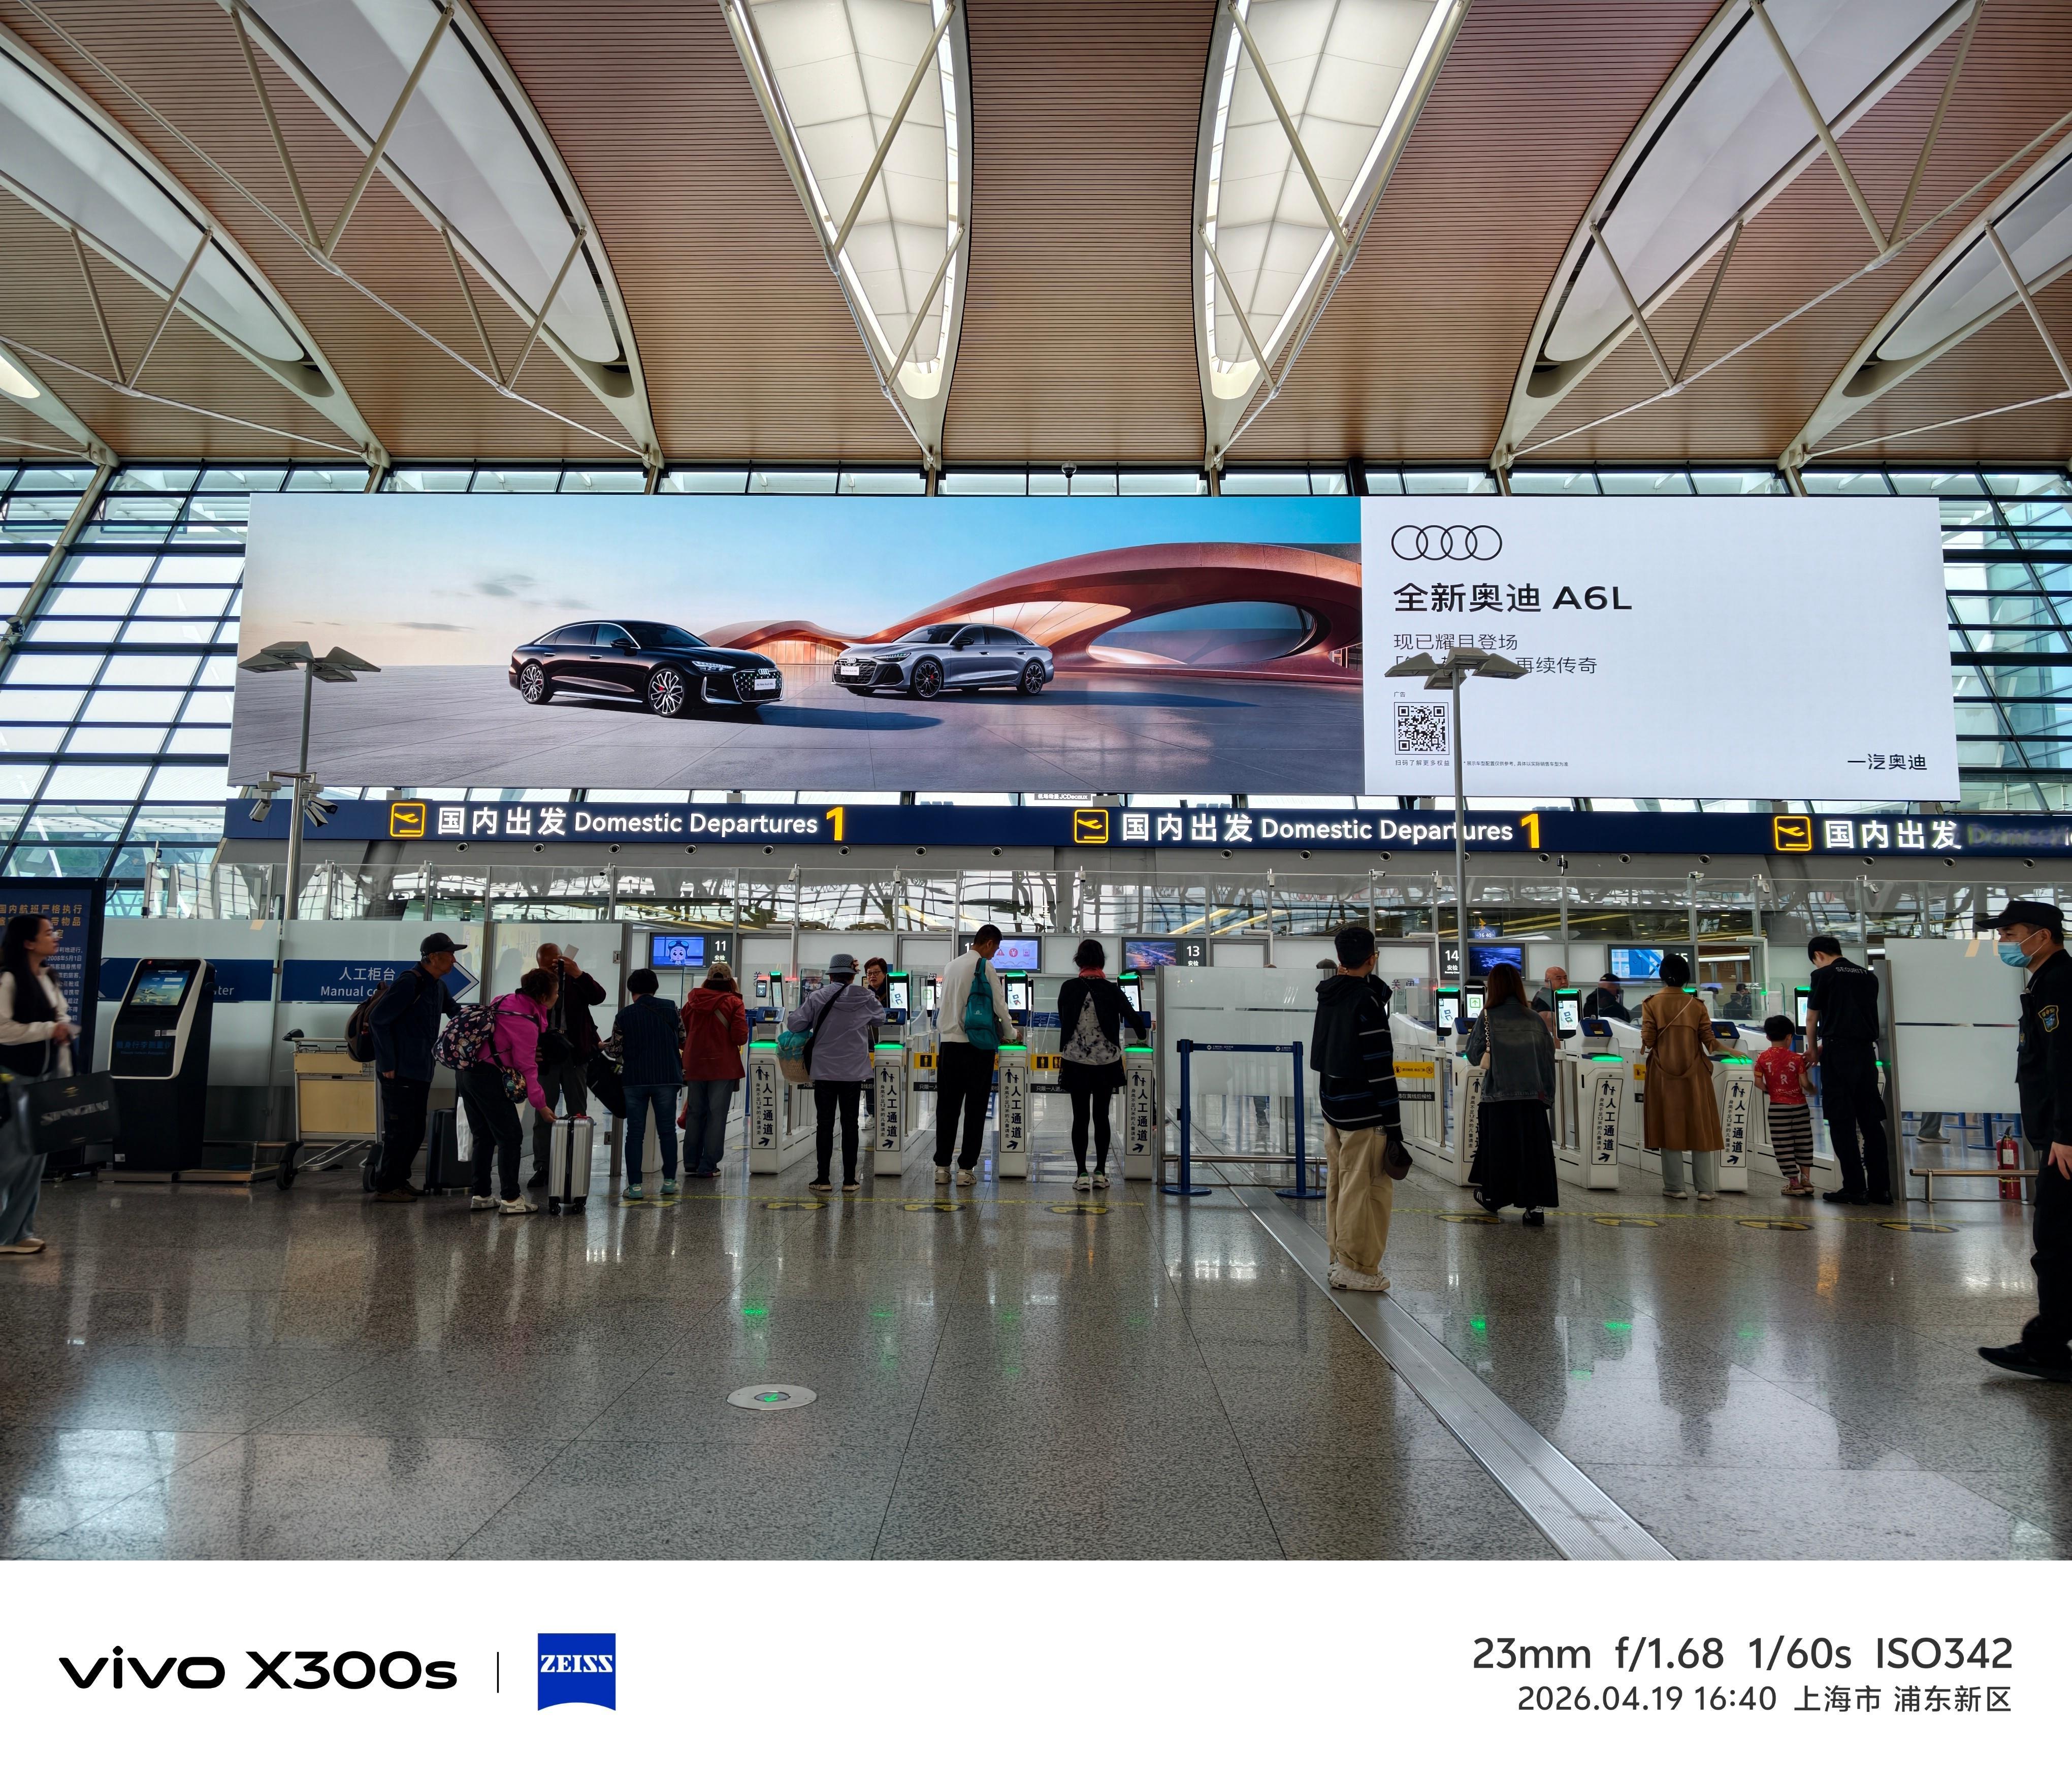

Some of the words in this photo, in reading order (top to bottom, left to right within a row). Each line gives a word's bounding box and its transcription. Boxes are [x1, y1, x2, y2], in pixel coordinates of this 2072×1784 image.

[1394, 582, 1541, 613] 全新奥迪
[1552, 586, 1632, 610] A6L
[1394, 633, 1518, 650] 现已耀目登场
[1847, 753, 1927, 770] 一汽奥迪
[438, 806, 566, 836] 国内出发
[575, 812, 682, 833] Domestic
[690, 814, 818, 838] Departures
[826, 807, 844, 841] 1
[1122, 813, 1253, 842] 国内出发
[1261, 818, 1372, 839] Domestic
[1380, 820, 1513, 845] Departures
[1521, 813, 1540, 848] 1
[1825, 820, 1962, 849] 国内出发
[715, 940, 726, 951] 11
[964, 942, 974, 952] 1
[1186, 945, 1200, 957] 13
[1445, 950, 1460, 961] 14
[1675, 953, 1688, 963] 5
[339, 967, 396, 981] 人工柜台
[1835, 966, 1867, 975] SECURITY
[320, 985, 363, 996] Manual
[1391, 979, 1415, 989] 关闭
[1765, 1062, 1772, 1073] T
[1788, 1061, 1796, 1072] S
[1780, 1074, 1788, 1085] R
[763, 1083, 773, 1135] 人工通道
[887, 1085, 897, 1137] 人工通道
[1011, 1086, 1022, 1138] 人工通道
[1137, 1089, 1148, 1141] 人工通道
[1603, 1098, 1616, 1151] 人工通道
[1732, 1100, 1745, 1153] 人工通道
